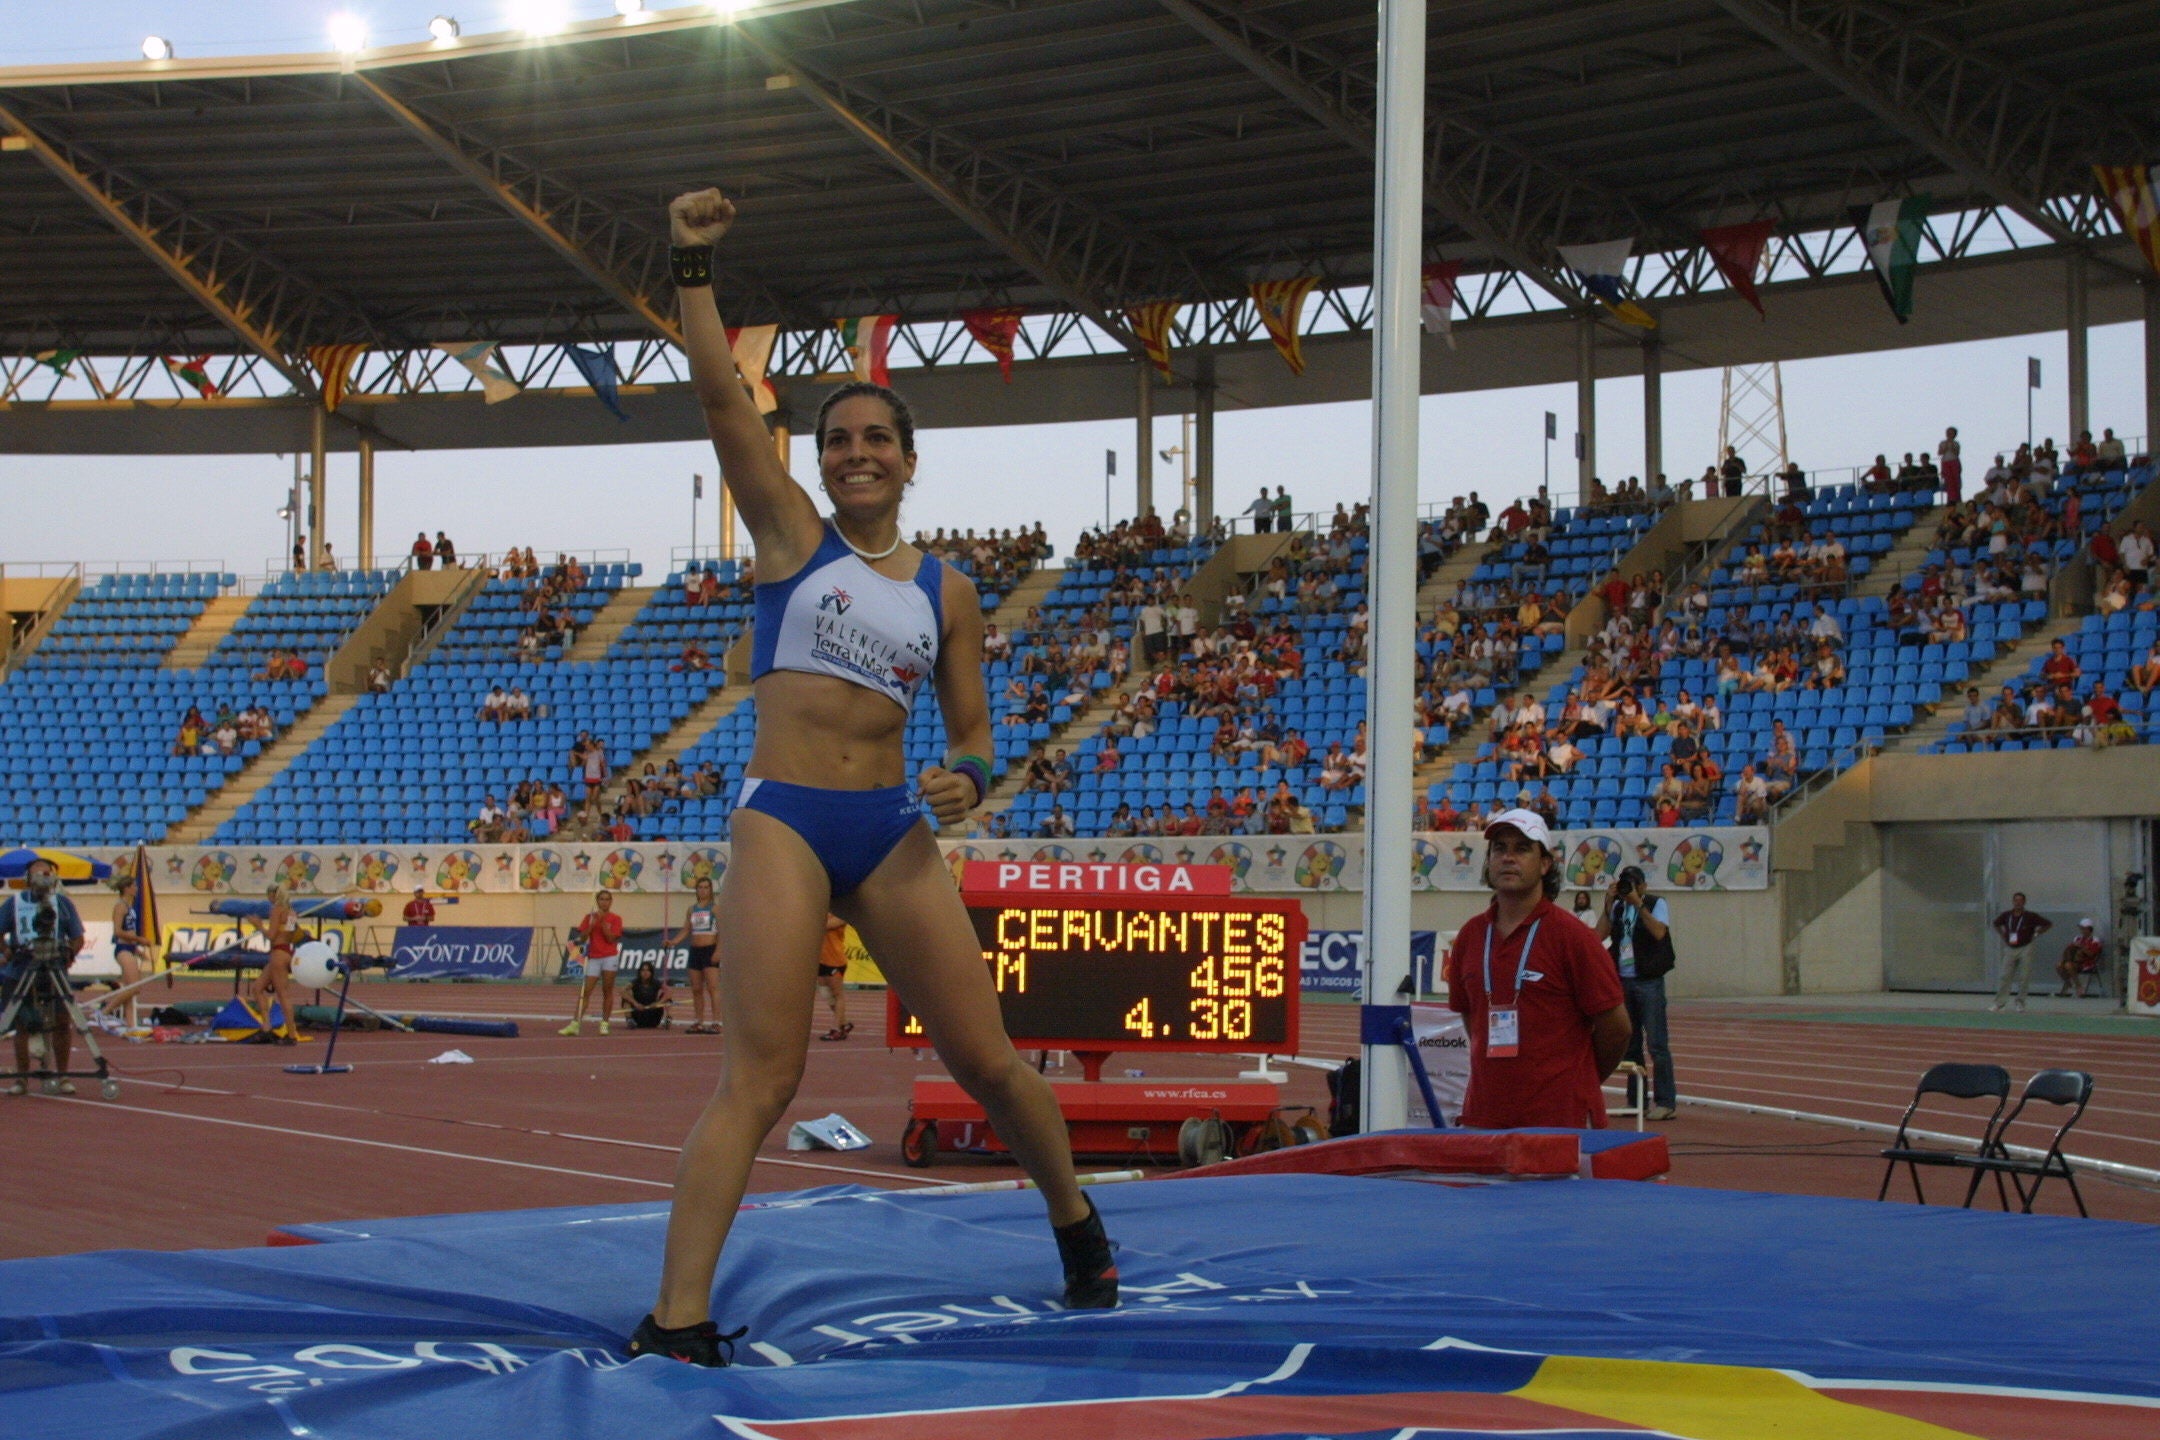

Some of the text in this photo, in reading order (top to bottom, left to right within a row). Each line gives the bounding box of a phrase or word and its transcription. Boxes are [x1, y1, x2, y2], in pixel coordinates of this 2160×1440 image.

[814, 632, 850, 659] Terra
[861, 655, 889, 678] Mar
[816, 615, 898, 663] VALENCIA
[1000, 864, 1194, 892] PERTIGA
[171, 928, 342, 954] MONO
[998, 909, 1284, 953] CERVANTES
[1190, 956, 1284, 998] 456
[1124, 998, 1252, 1040] 4.30
[1419, 1035, 1468, 1049] Reebok
